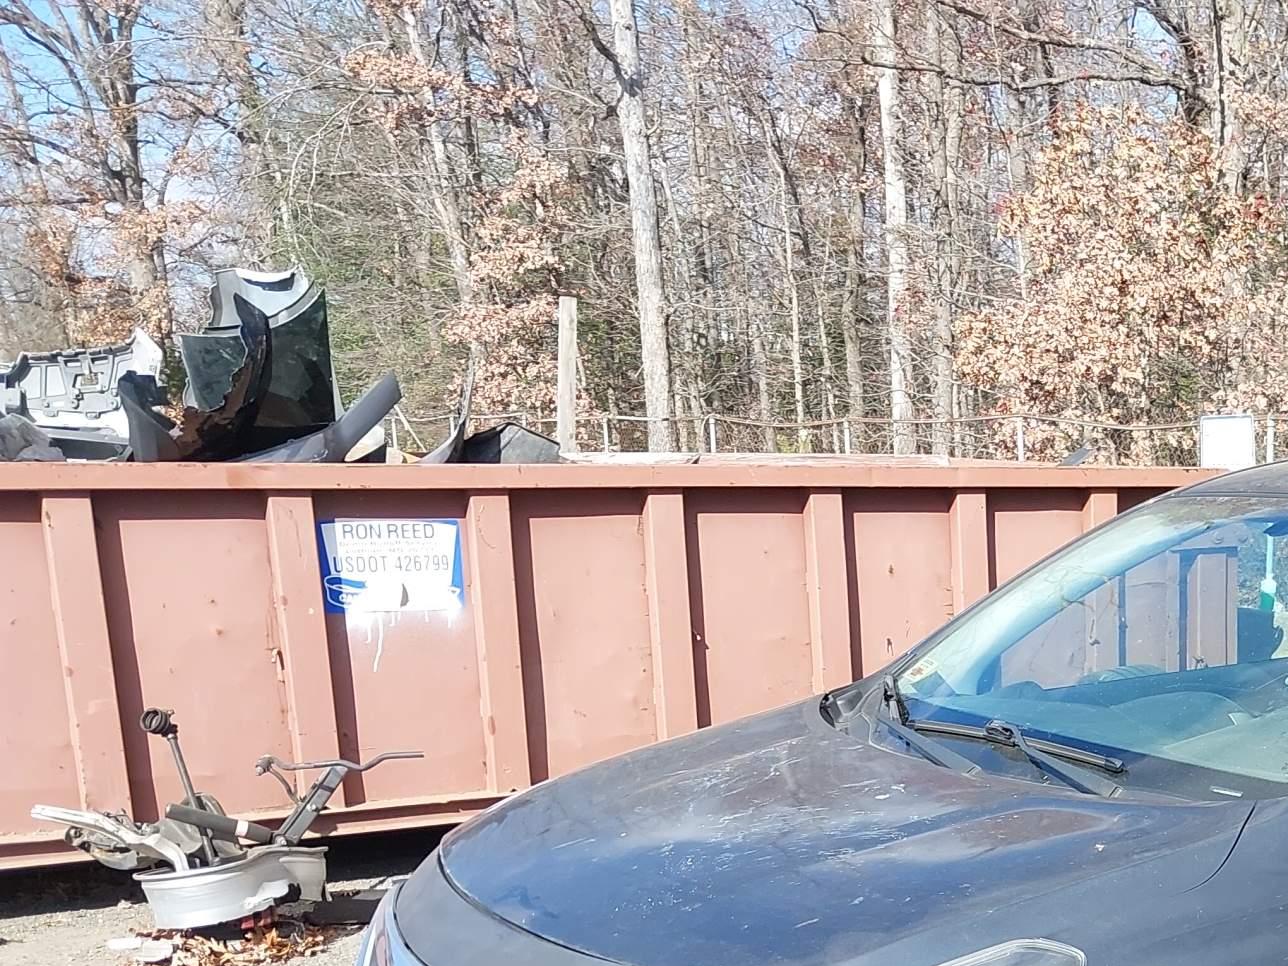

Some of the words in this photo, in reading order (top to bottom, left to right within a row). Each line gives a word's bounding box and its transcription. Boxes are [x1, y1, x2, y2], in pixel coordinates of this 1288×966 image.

[342, 523, 382, 540] RON
[387, 523, 435, 540] REED
[333, 555, 387, 574] USDOT
[395, 555, 449, 572] 426799
